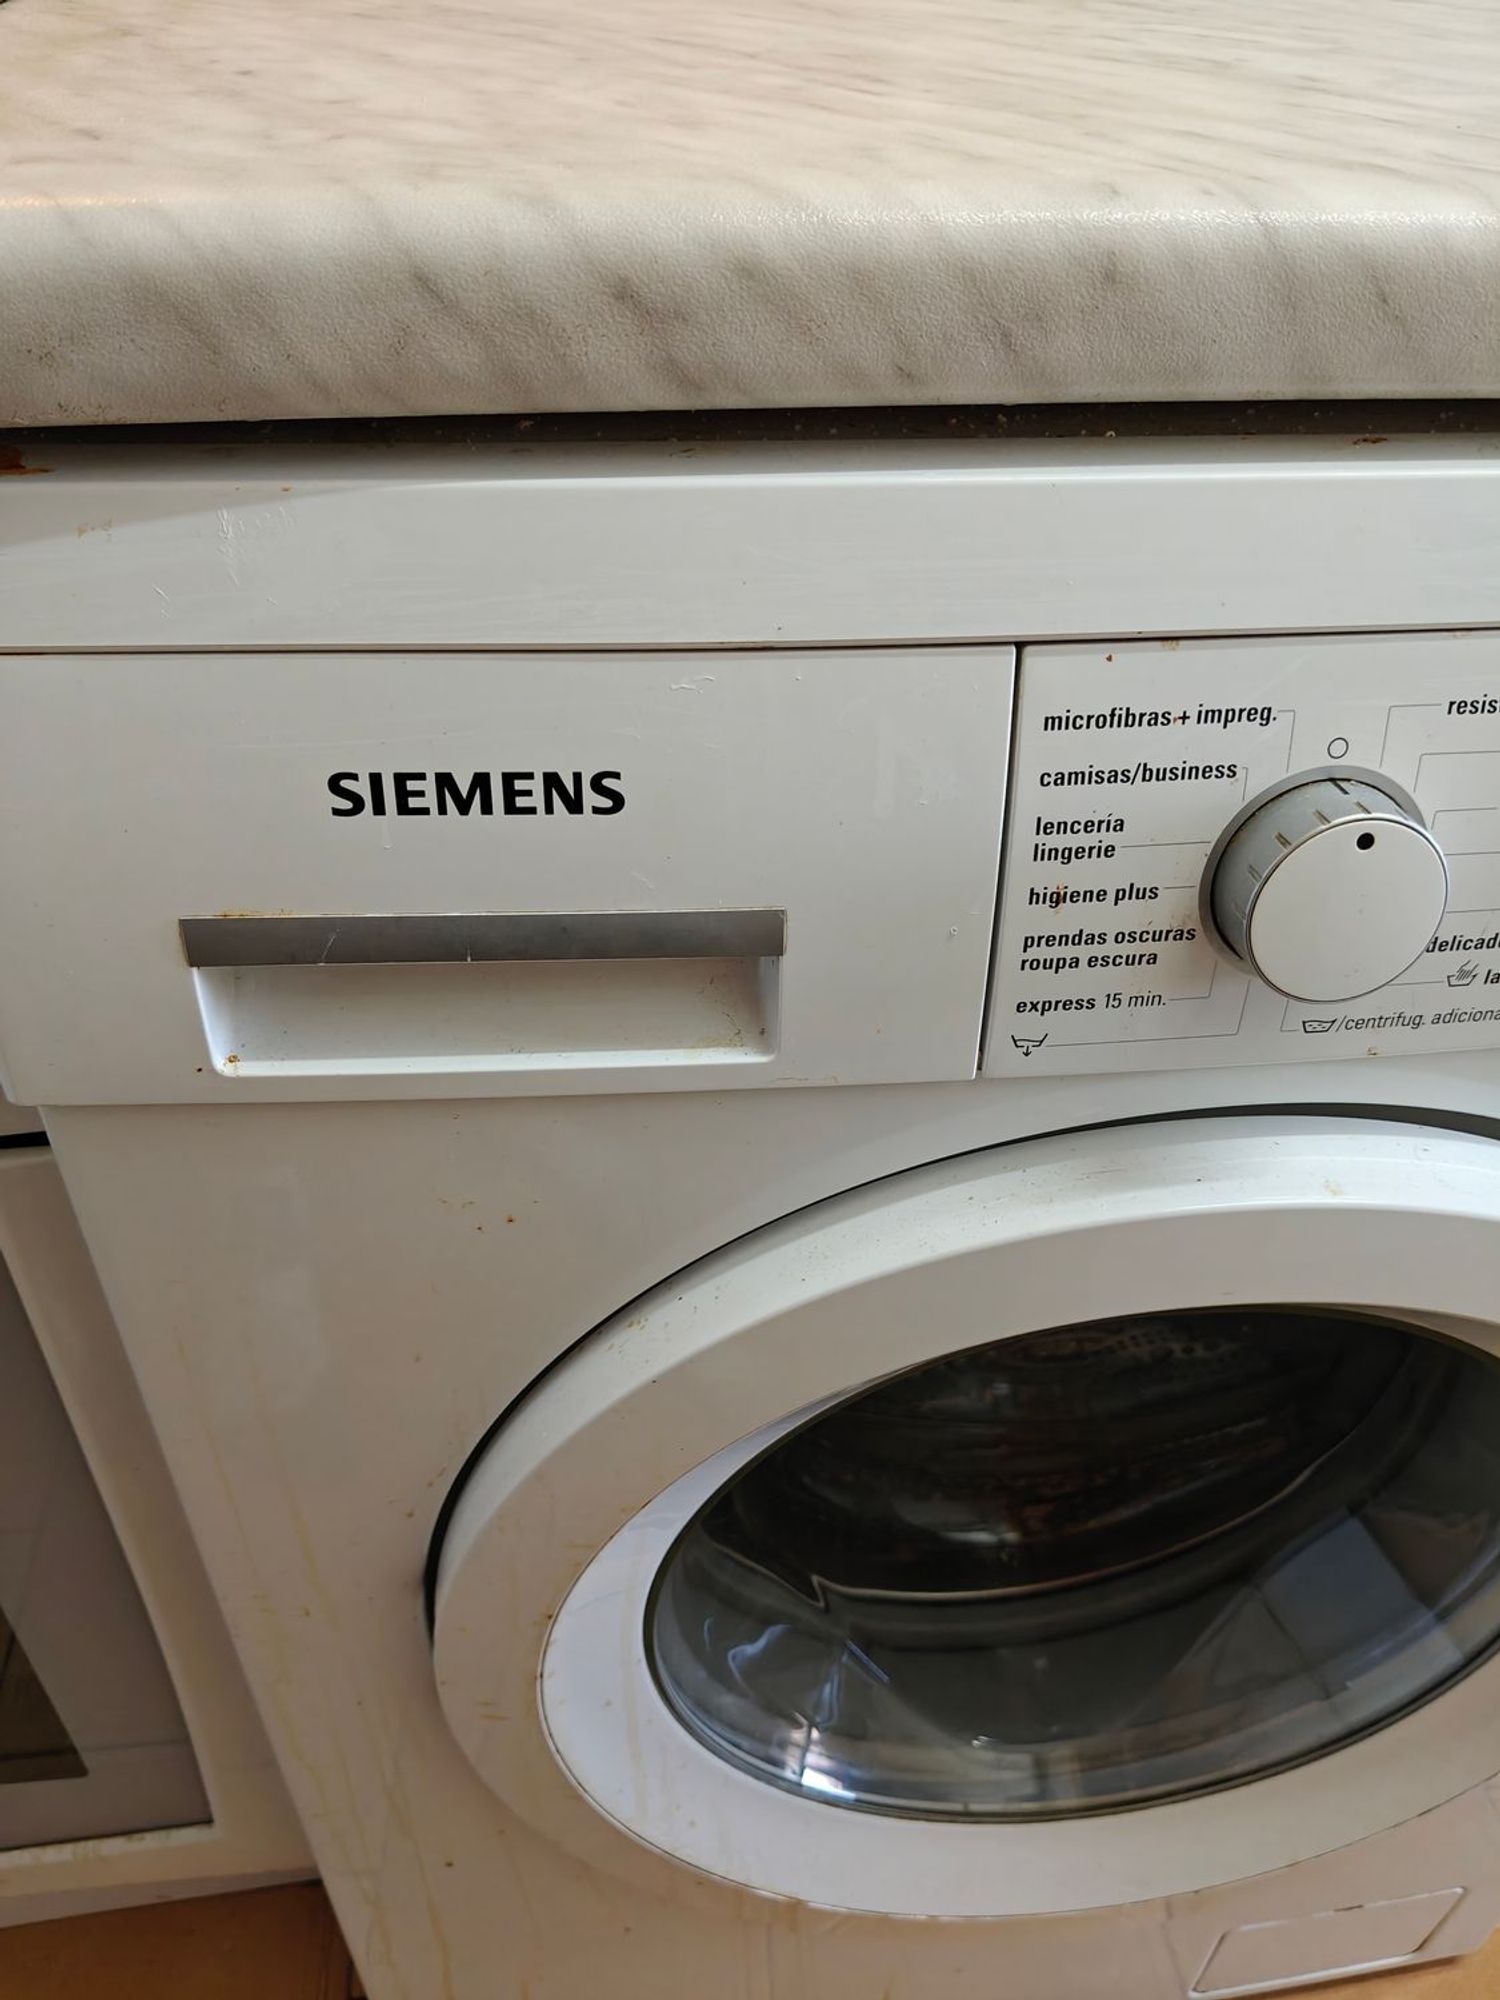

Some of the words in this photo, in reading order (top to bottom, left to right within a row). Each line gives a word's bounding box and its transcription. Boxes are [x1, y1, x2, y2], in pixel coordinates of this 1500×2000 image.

[1447, 693, 1500, 715] resis
[1043, 706, 1172, 732] microfibras
[1177, 710, 1191, 726] +
[1196, 703, 1277, 730] impreg.
[1039, 760, 1238, 788] camisas/business
[327, 770, 626, 817] SIEMENS
[1035, 813, 1125, 836] lencería
[1033, 840, 1116, 865] lingerie
[1028, 885, 1107, 909] higiene
[1113, 882, 1160, 906] plus
[1022, 928, 1108, 953] prendas
[1114, 927, 1197, 945] oscuras
[1425, 932, 1500, 954] delicad
[1020, 956, 1080, 974] roupa
[1087, 952, 1158, 968] escura
[1016, 997, 1096, 1017] express
[1104, 992, 1122, 1009] 15
[1127, 990, 1166, 1008] min.
[1335, 1011, 1426, 1033] /centrifug.
